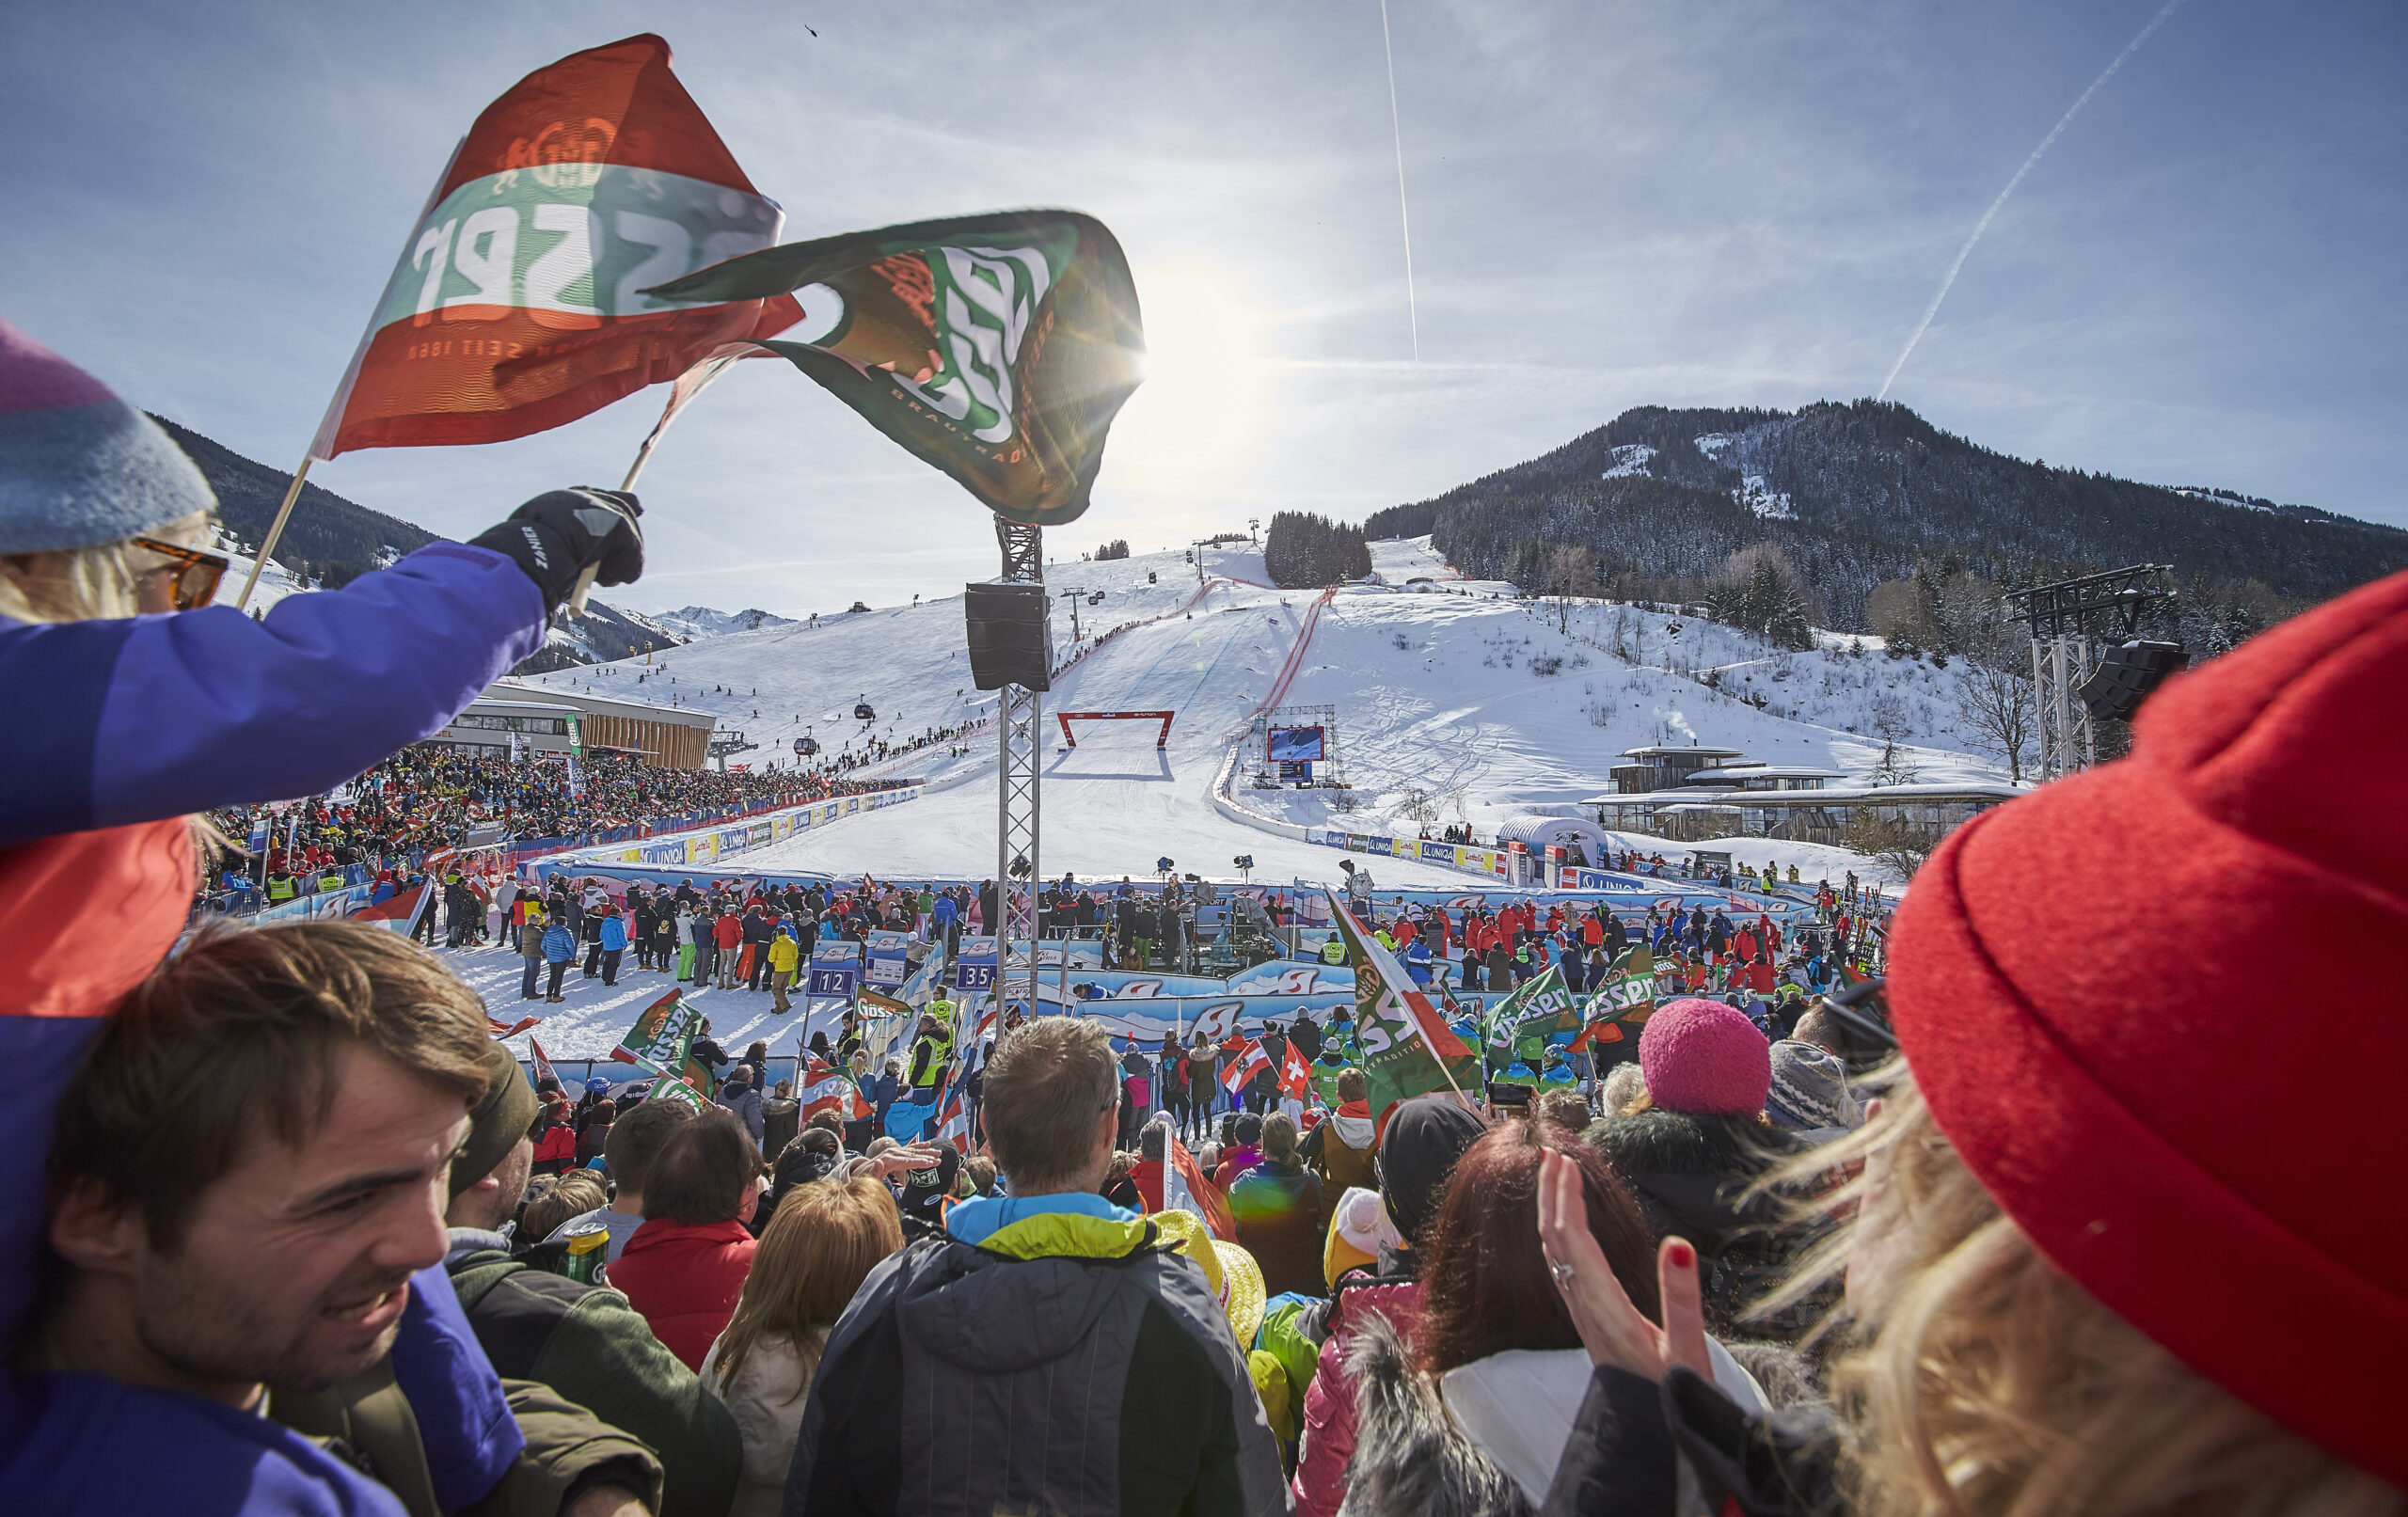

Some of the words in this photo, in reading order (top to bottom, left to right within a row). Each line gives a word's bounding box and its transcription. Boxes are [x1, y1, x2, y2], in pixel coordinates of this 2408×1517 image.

[520, 526, 549, 570] ZANIER
[728, 834, 746, 848] UNIQA
[1375, 842, 1391, 853] UNIQA
[657, 846, 684, 864] UNIQA
[1431, 846, 1453, 861] UNIQA
[822, 972, 843, 993] 12
[966, 968, 988, 987] 35
